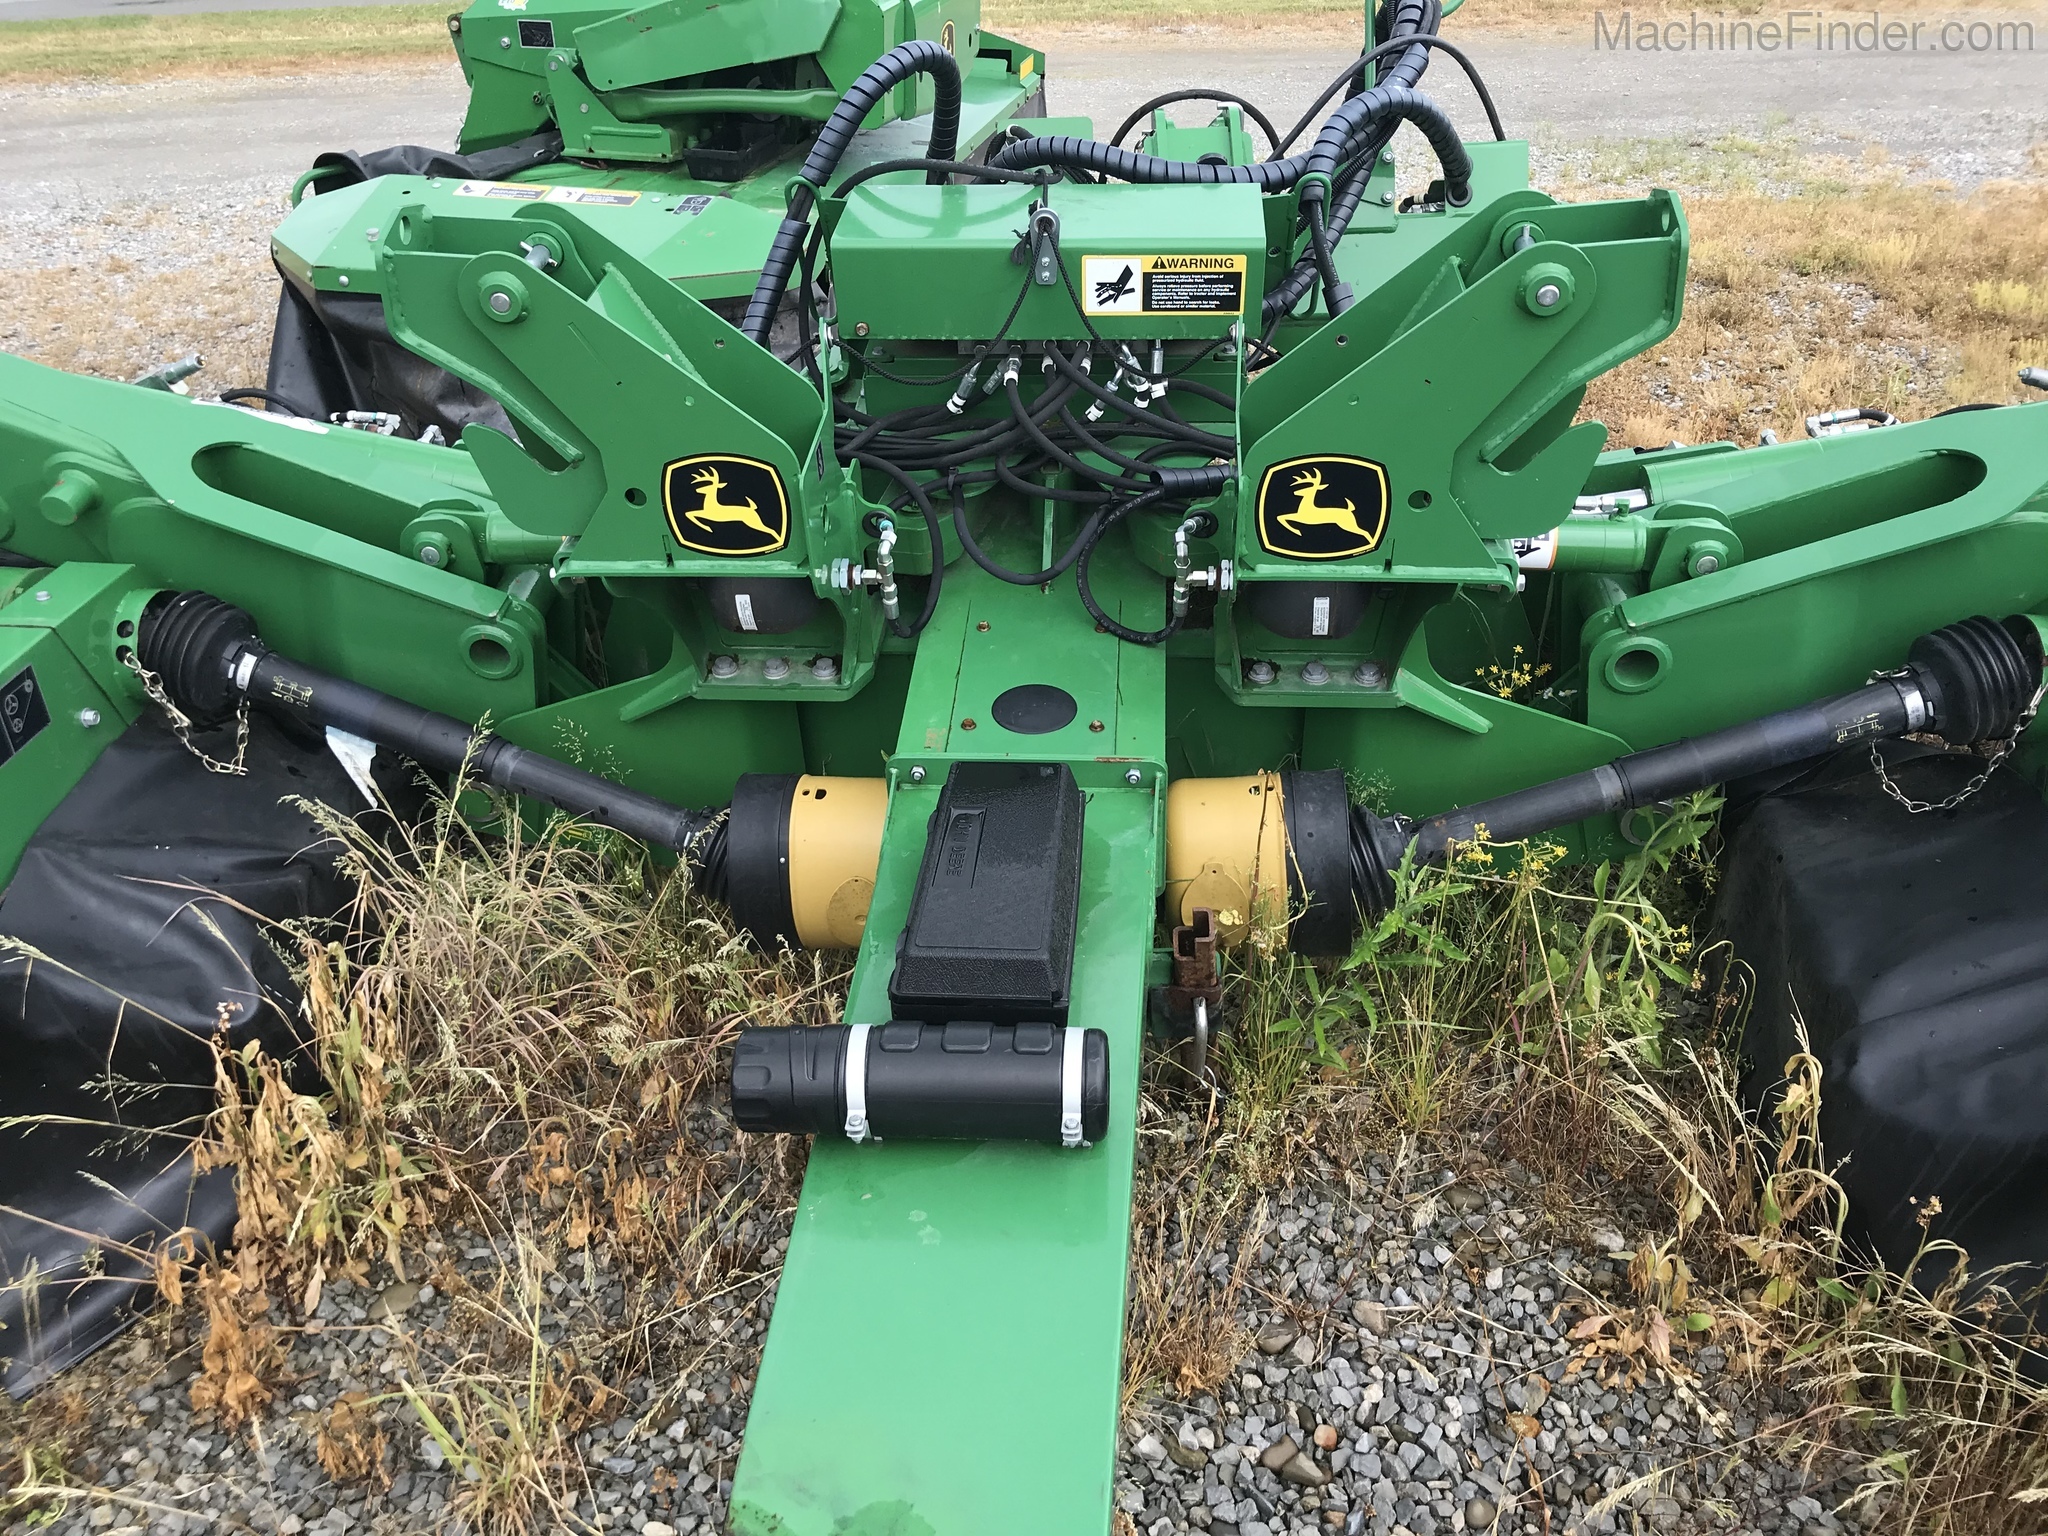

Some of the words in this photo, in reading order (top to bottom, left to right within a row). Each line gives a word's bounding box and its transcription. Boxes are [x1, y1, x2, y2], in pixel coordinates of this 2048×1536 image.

[1166, 258, 1234, 269] WARNING
[1147, 490, 1161, 498] Made
[946, 846, 967, 877] DEERE
